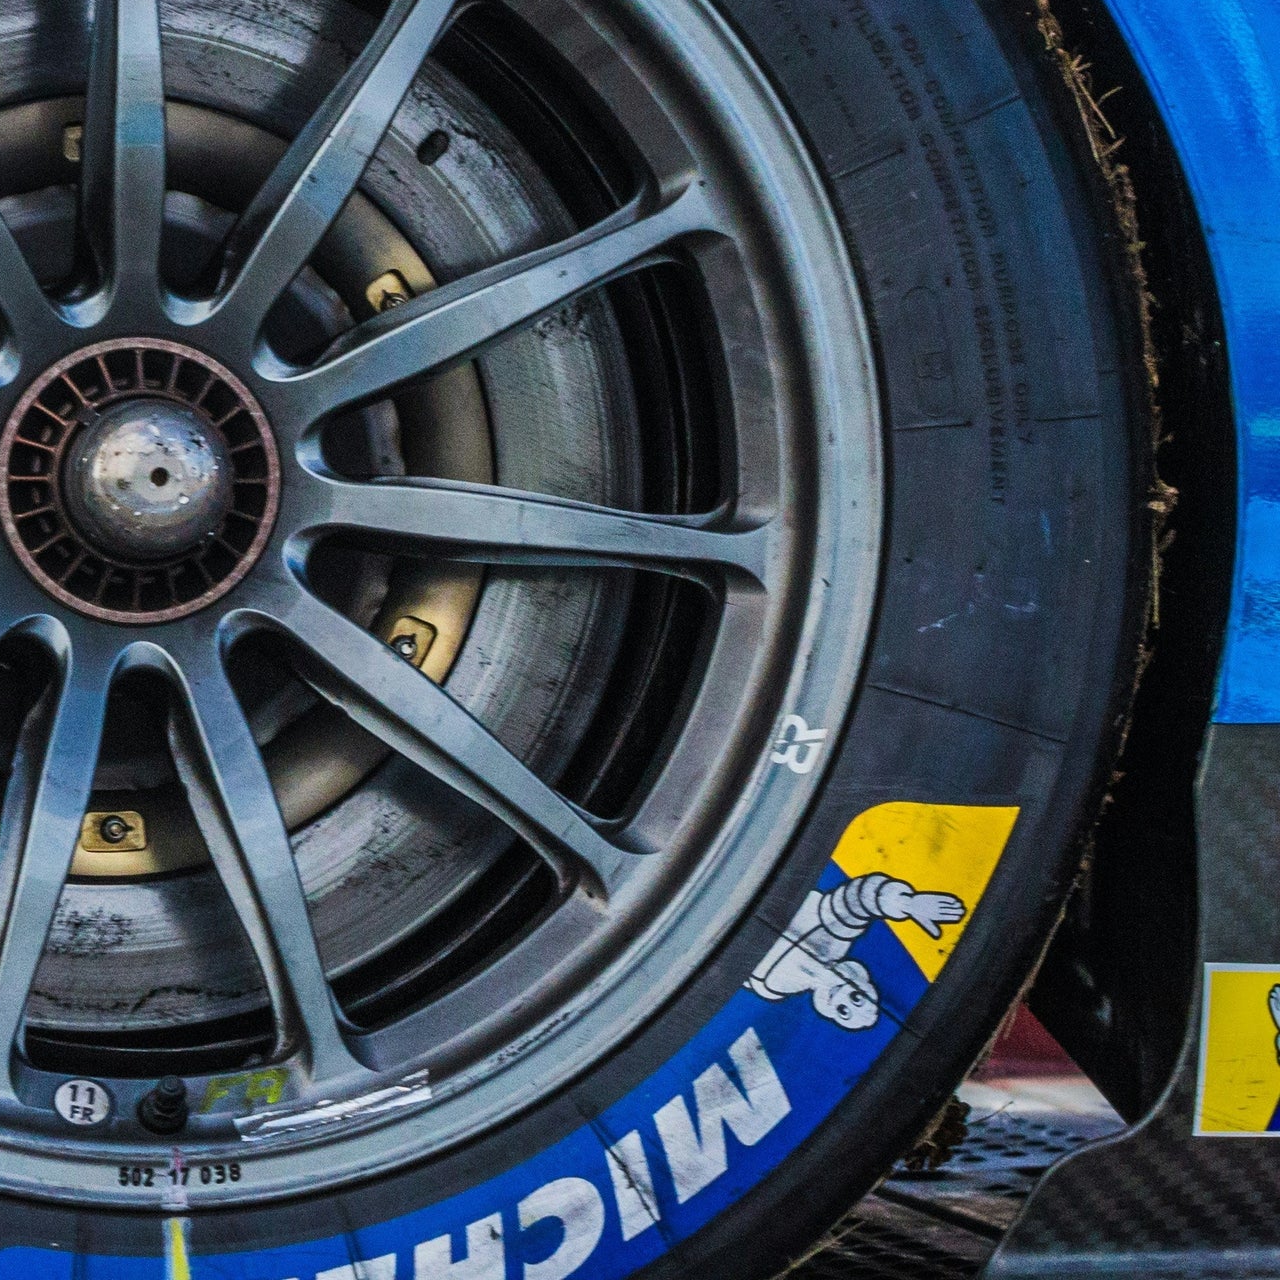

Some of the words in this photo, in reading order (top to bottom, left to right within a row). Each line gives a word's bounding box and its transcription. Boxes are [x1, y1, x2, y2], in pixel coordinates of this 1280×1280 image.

[68, 1083, 97, 1105] 11
[68, 1104, 96, 1122] FR
[118, 1165, 155, 1188] 502
[200, 1163, 242, 1185] 038
